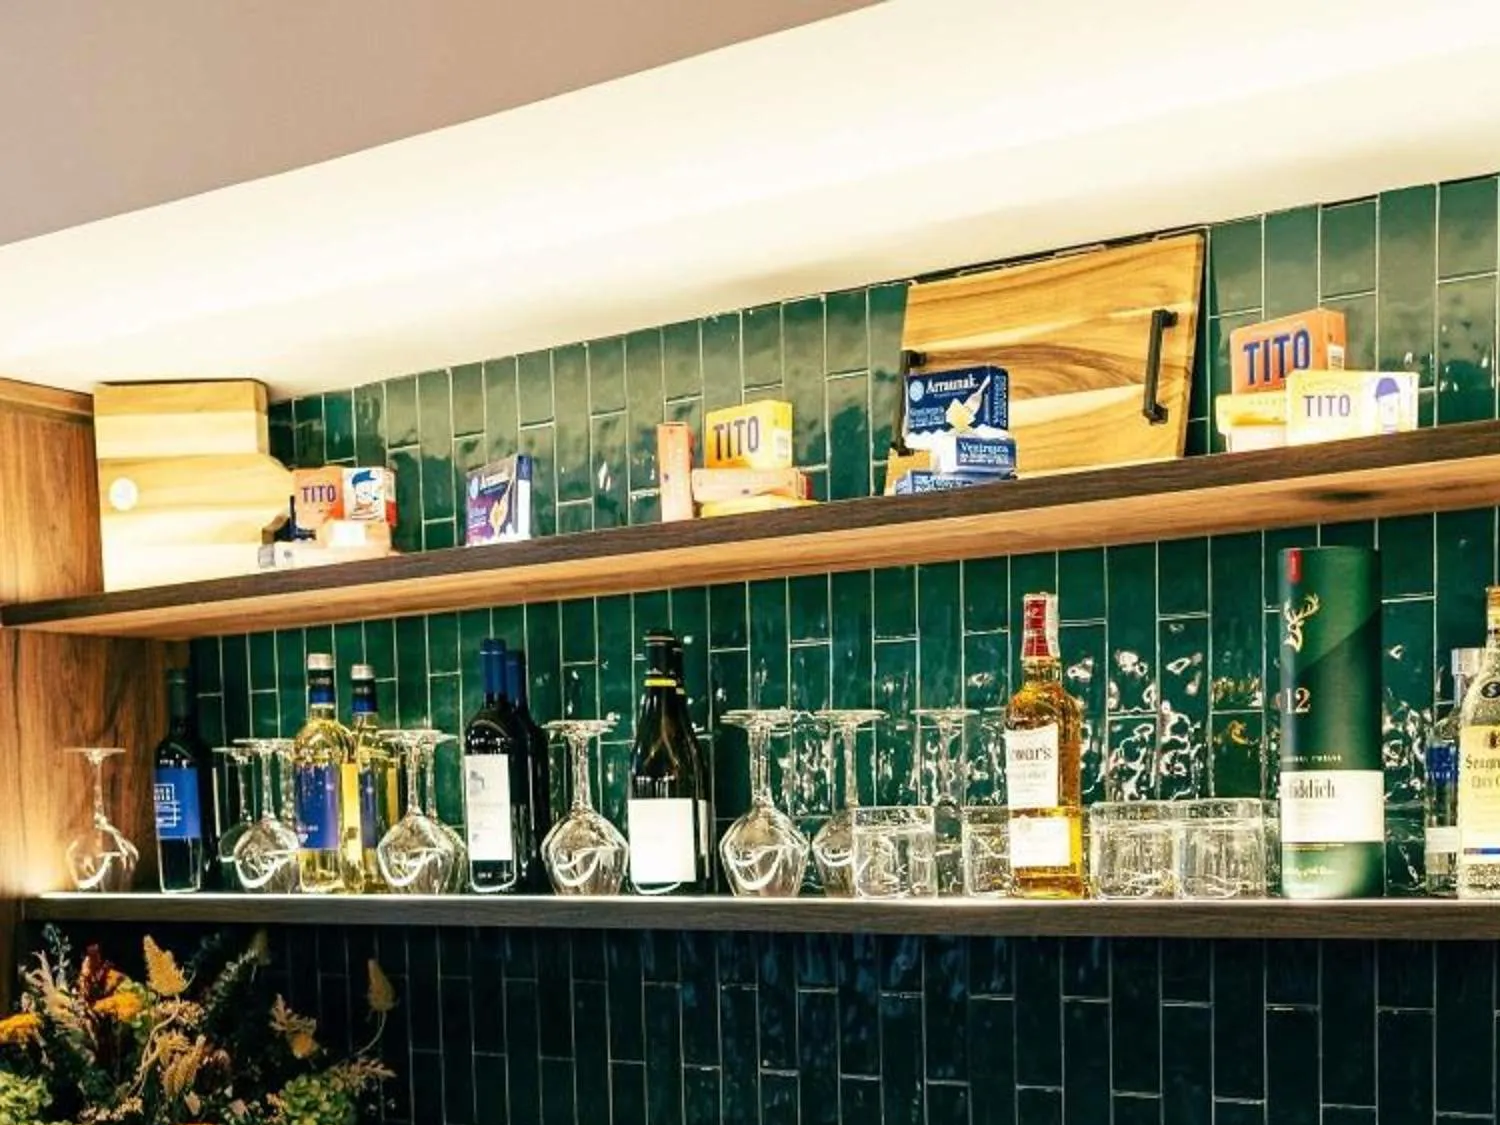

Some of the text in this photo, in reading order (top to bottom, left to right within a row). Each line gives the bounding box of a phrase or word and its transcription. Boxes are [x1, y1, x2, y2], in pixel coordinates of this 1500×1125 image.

[1243, 329, 1311, 386] TITO
[1304, 394, 1350, 417] TITO
[713, 415, 759, 461] TITO
[302, 484, 336, 502] TITO
